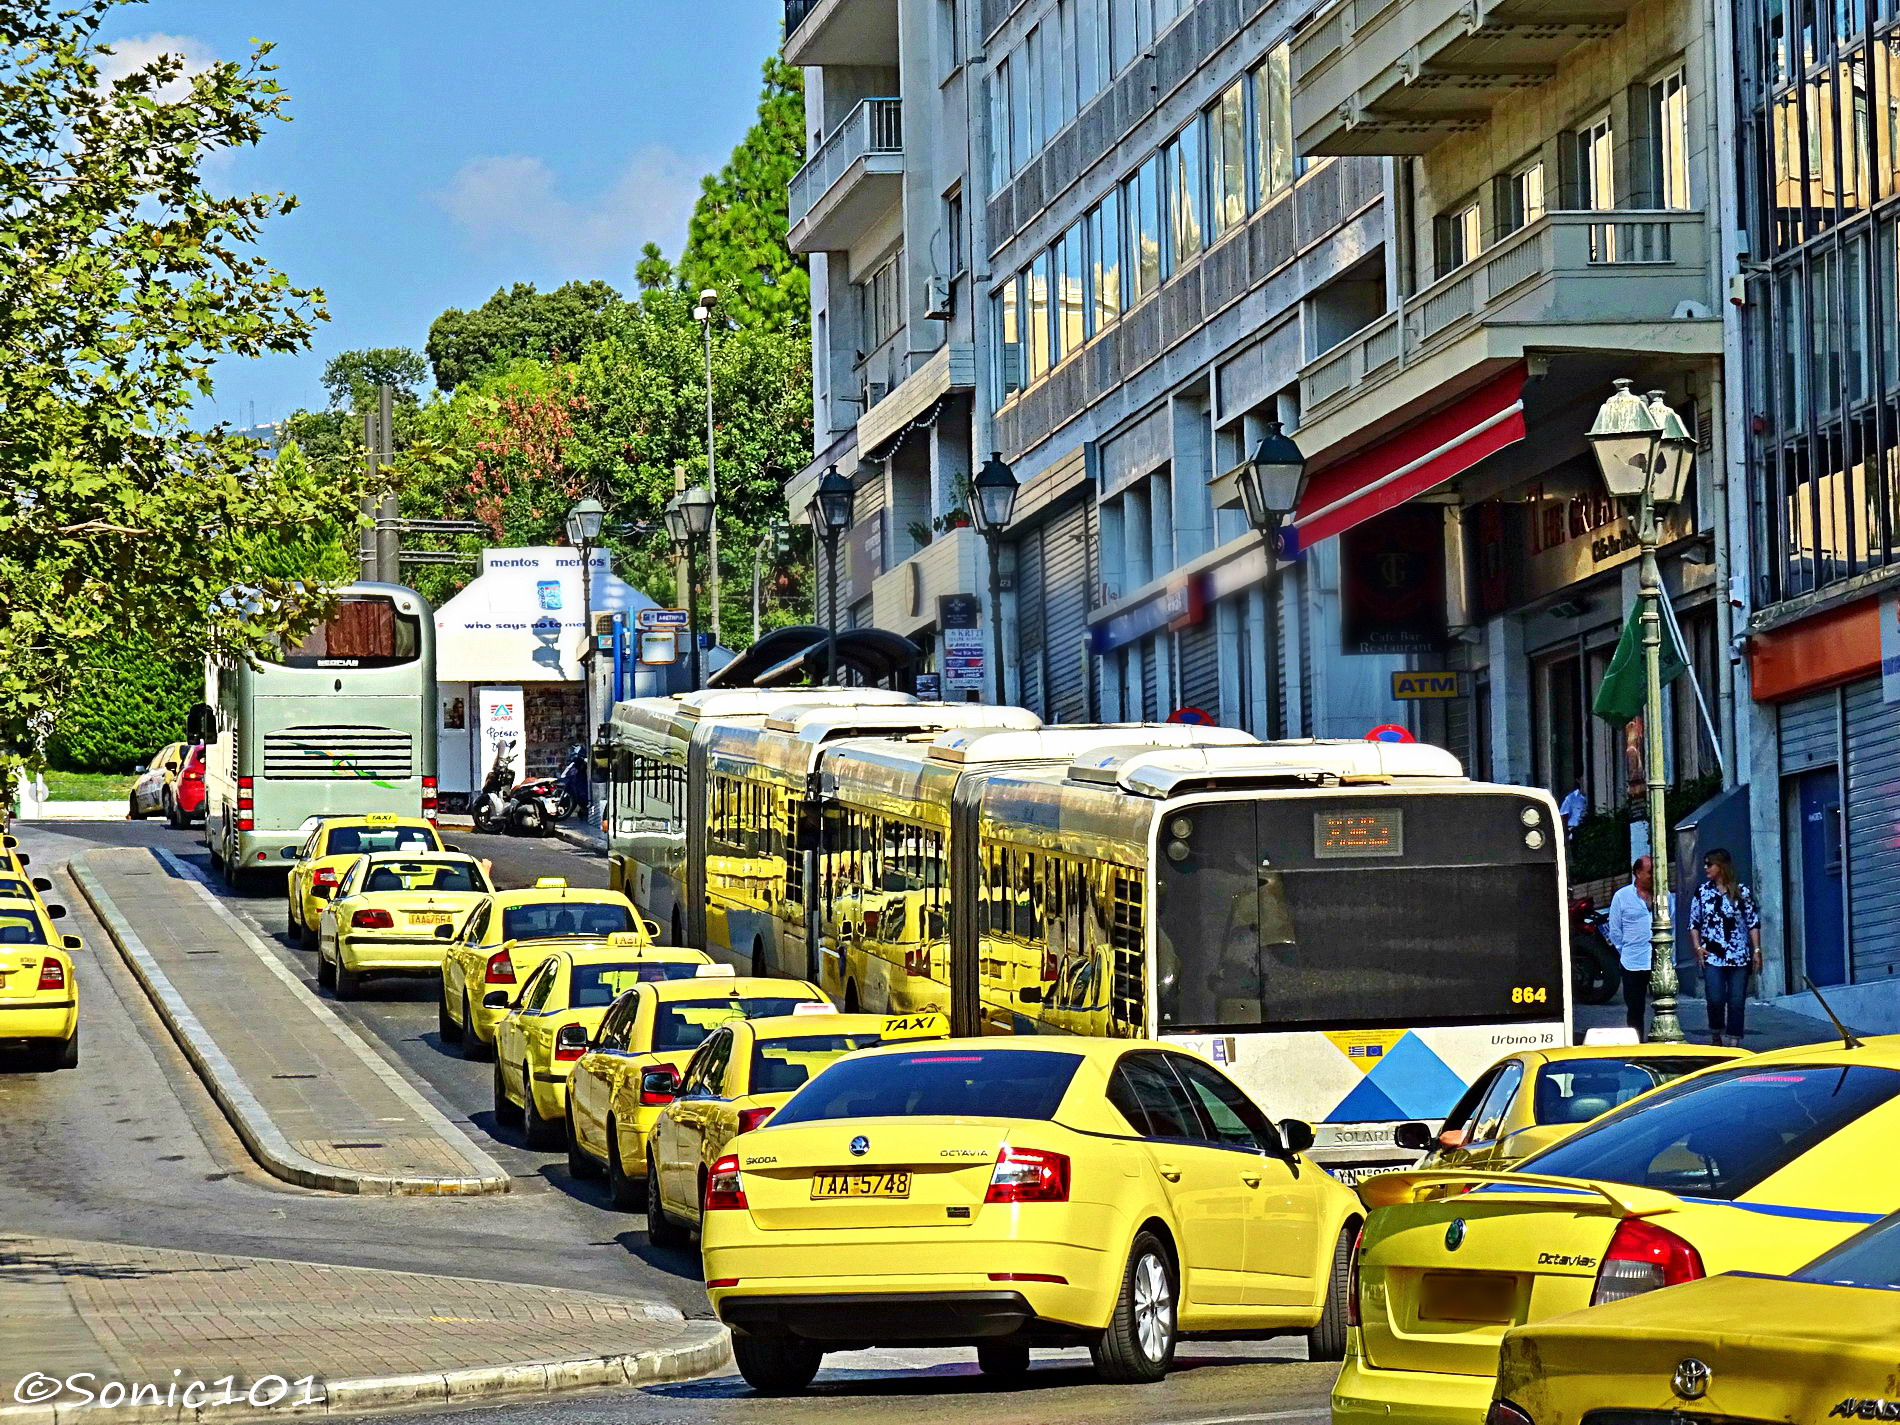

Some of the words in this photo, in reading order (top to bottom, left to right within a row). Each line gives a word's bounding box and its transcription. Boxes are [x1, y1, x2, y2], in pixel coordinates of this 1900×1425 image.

[490, 557, 539, 567] mentos
[555, 556, 606, 567] menos
[464, 621, 492, 629] who
[495, 622, 527, 630] says
[531, 621, 547, 629] no
[548, 620, 562, 628] to
[1400, 630, 1421, 641] Bar
[1360, 642, 1433, 653] Restaurant
[1397, 678, 1455, 693] ATM
[1511, 986, 1547, 1003] 864
[884, 1016, 936, 1032] TAXI
[1491, 1034, 1537, 1045] Urbino
[1539, 1033, 1554, 1043] 18
[939, 1149, 988, 1157] OCTAVIA
[1537, 1252, 1597, 1268] Octavias
